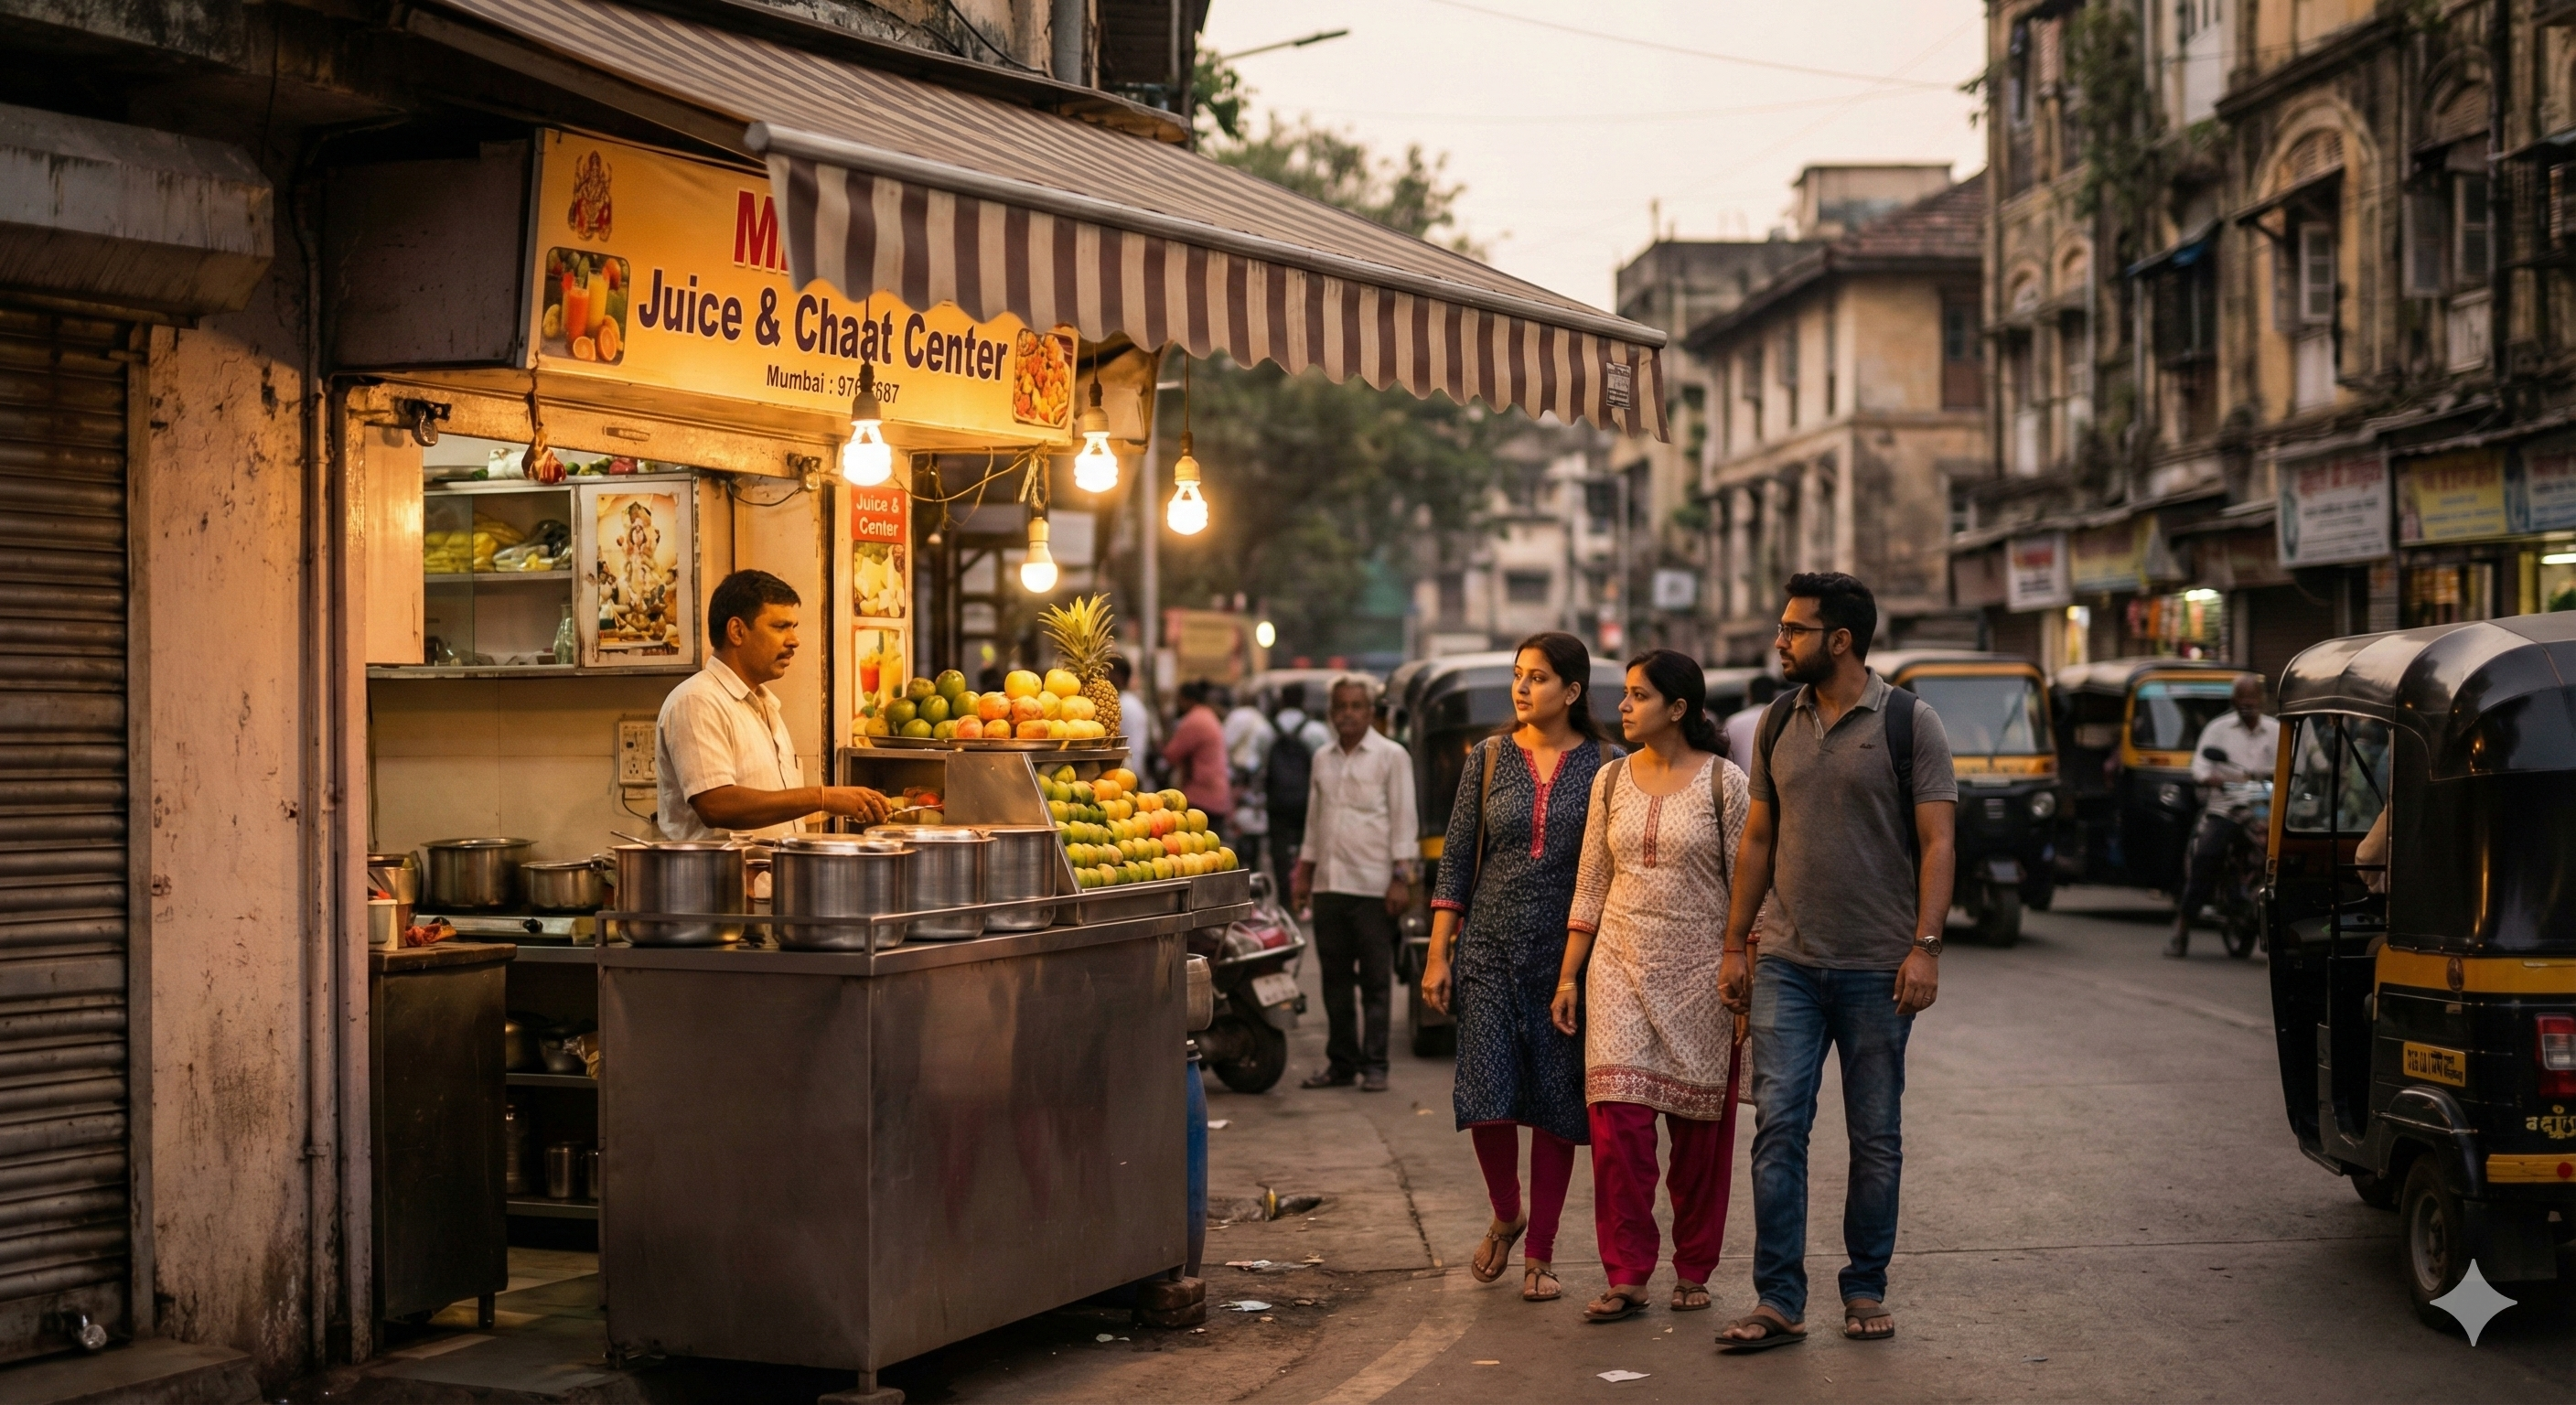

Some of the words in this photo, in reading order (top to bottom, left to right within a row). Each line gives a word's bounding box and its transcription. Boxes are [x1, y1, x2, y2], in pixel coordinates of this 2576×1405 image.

[638, 269, 743, 341] Juice
[756, 286, 781, 347] &
[795, 294, 893, 364] Chaat
[904, 313, 1009, 381] Center
[767, 364, 825, 393] Mumbai
[856, 493, 888, 512] Juice
[891, 497, 899, 513] &
[859, 517, 898, 537] Center
